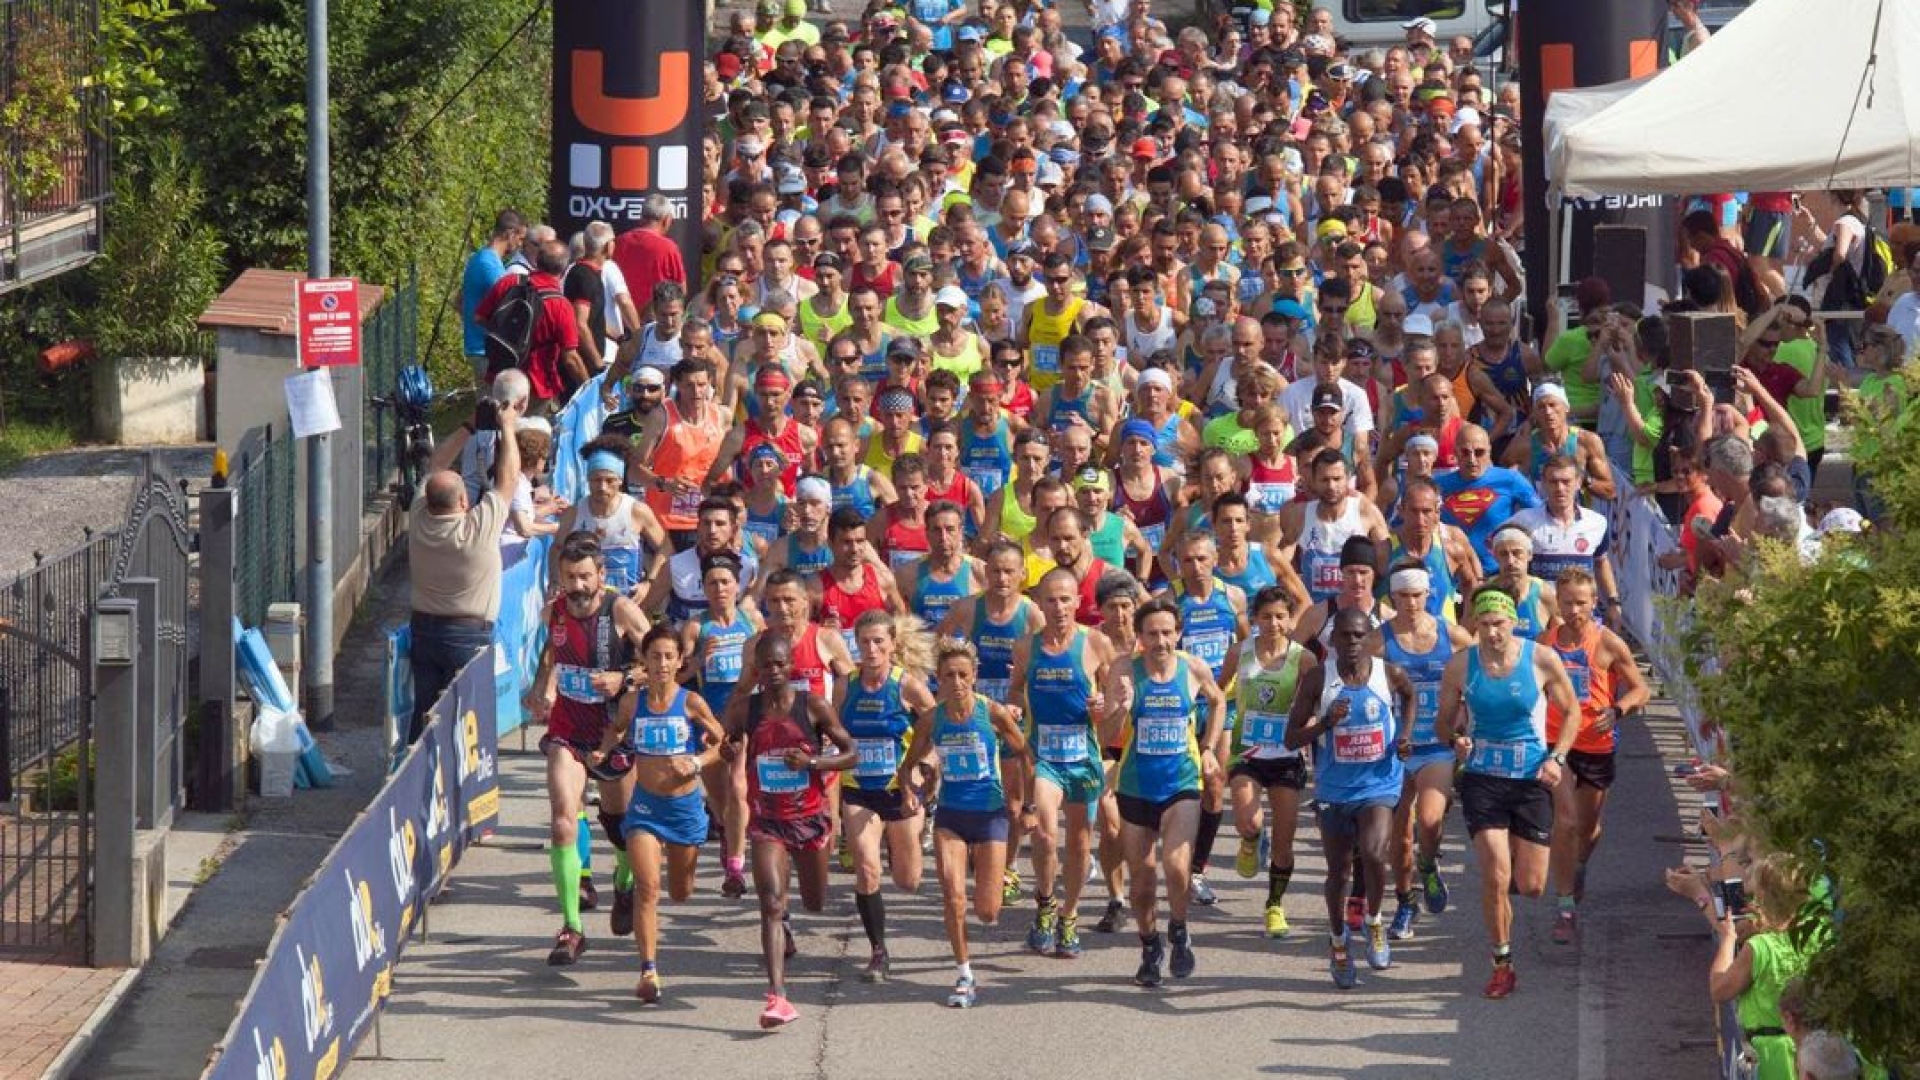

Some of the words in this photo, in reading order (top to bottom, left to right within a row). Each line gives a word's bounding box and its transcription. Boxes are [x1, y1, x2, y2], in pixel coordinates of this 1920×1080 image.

[571, 676, 587, 690] 91
[653, 727, 668, 742] 11
[1150, 727, 1179, 742] 350
[1349, 733, 1373, 746] JEAN
